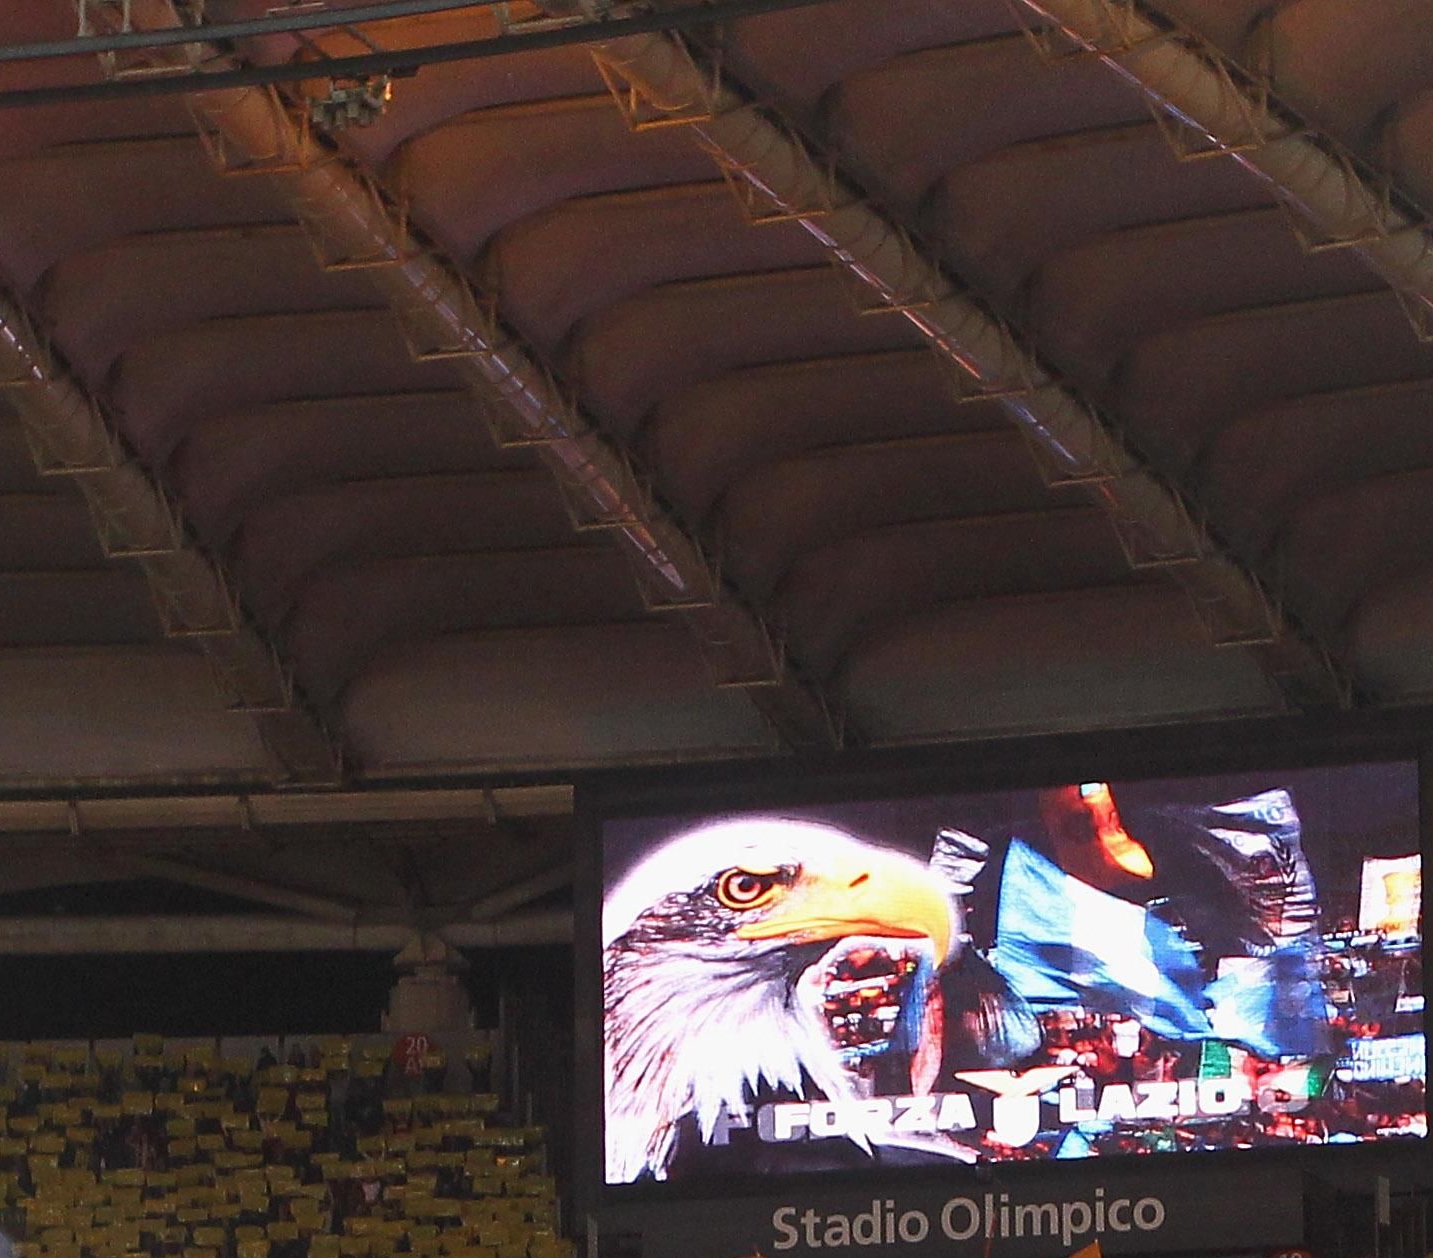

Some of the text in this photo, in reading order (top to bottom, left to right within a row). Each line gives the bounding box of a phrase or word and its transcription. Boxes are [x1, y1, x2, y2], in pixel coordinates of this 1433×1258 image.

[774, 1078, 1246, 1140] FORZA LAZIO
[772, 1187, 1166, 1251] Stadio Olimpico
